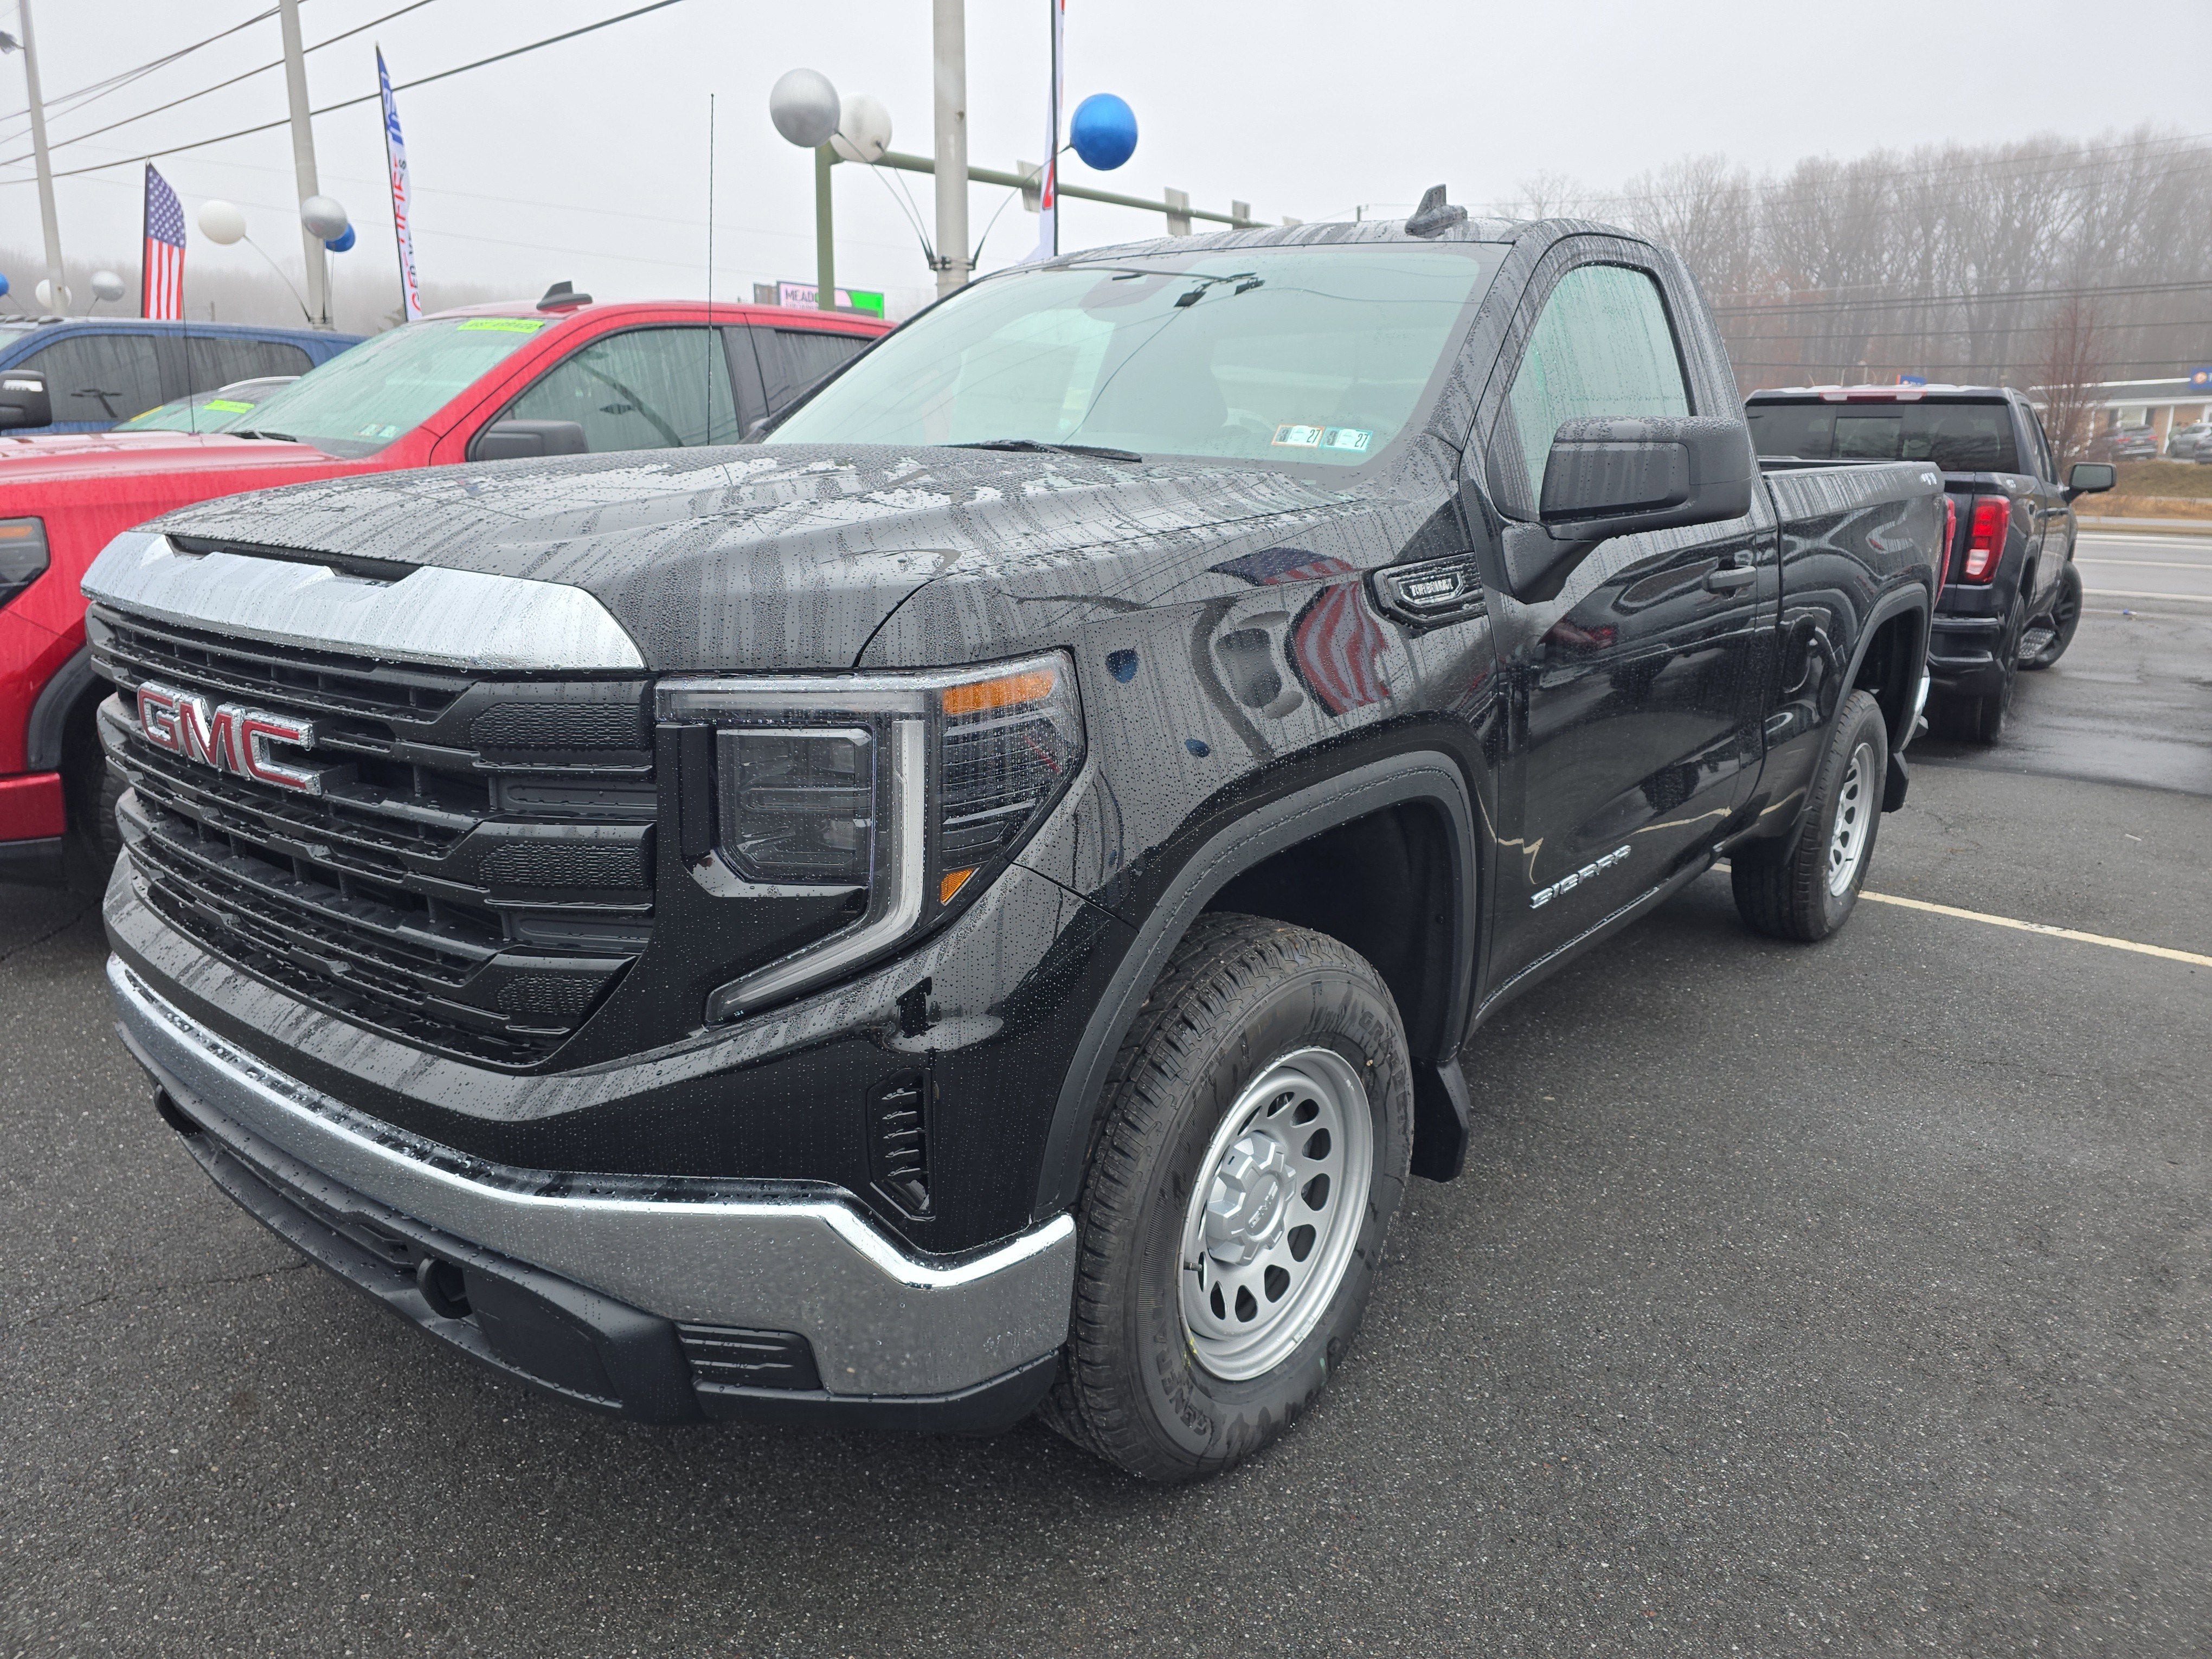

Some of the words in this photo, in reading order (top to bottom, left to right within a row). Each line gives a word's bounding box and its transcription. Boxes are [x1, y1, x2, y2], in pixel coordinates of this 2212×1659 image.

[1307, 429, 1321, 443] 27
[1354, 433, 1369, 448] 27
[137, 681, 323, 796] GMC
[1529, 844, 1632, 909] SIERRA
[1248, 1181, 1278, 1229] GMC
